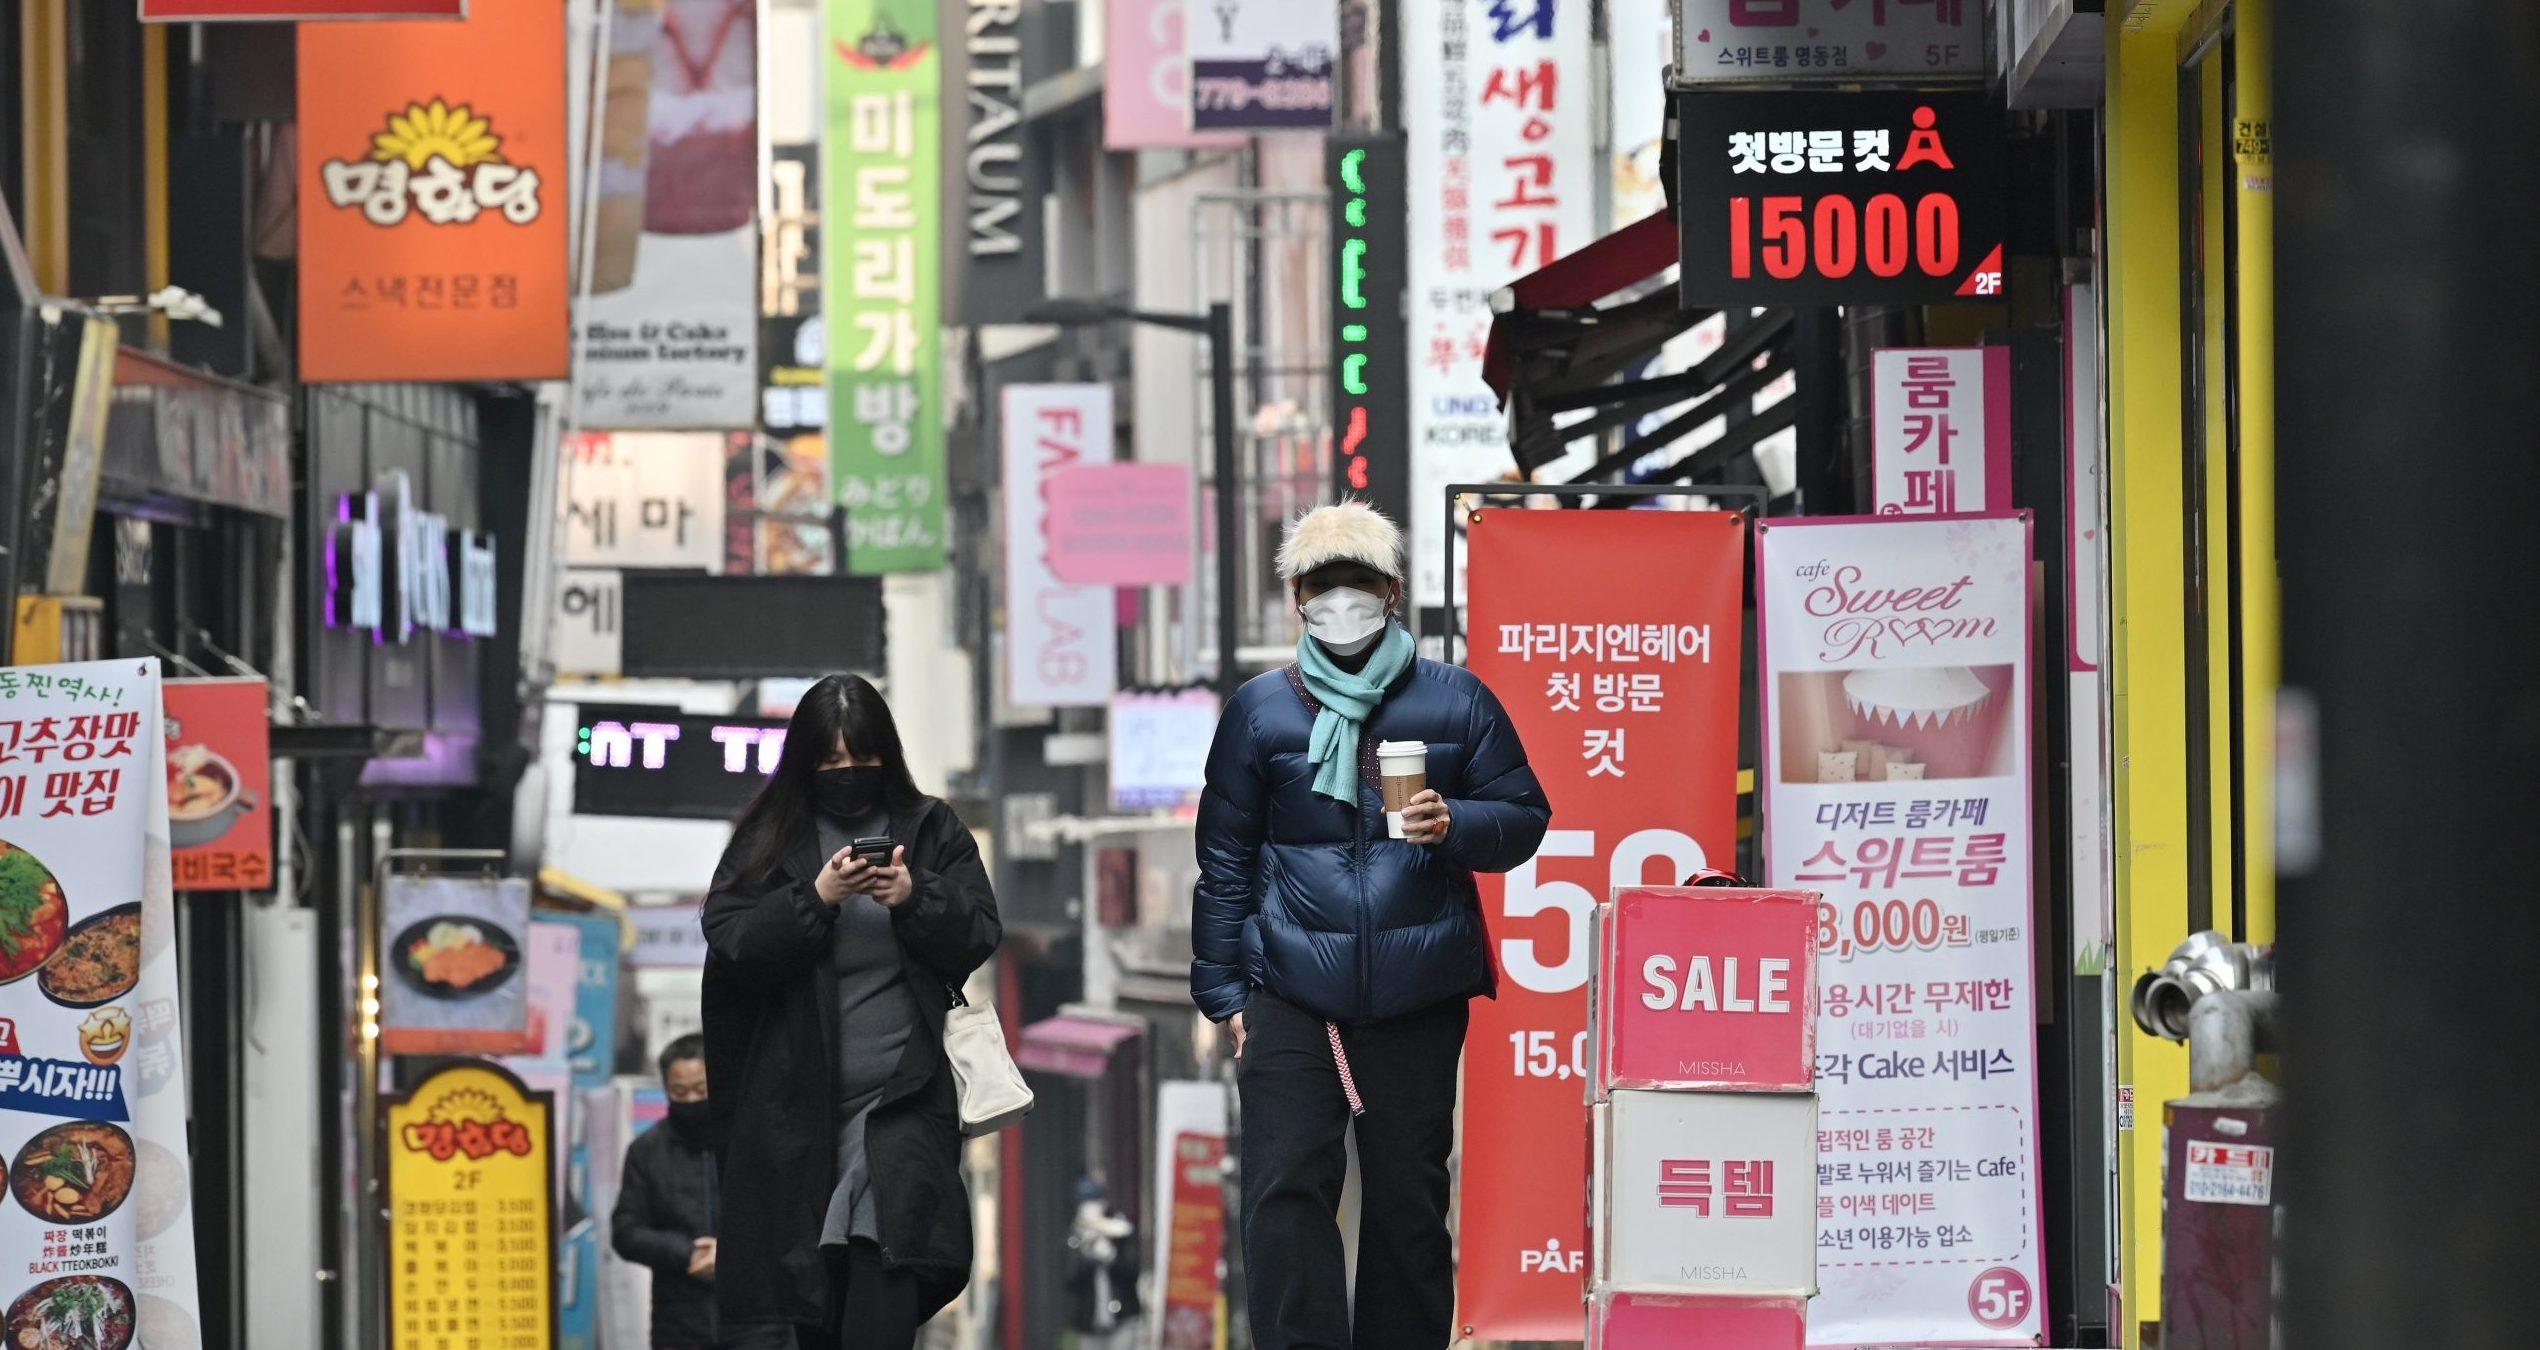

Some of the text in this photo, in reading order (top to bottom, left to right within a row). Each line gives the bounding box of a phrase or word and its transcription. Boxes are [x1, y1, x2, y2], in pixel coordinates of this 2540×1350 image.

[1717, 44, 1961, 67] 스위트룸 명동점 5F
[1481, 57, 1560, 268] 생고기
[1728, 129, 1891, 174] 첫방문 컷
[1730, 192, 1960, 280] 15000
[851, 90, 921, 453] 미도리가방
[1975, 272, 2002, 295] 2F
[341, 275, 518, 309] 스낵전문점
[1901, 356, 1959, 513] 룸카페
[1796, 559, 1830, 582] cafe
[1804, 565, 1974, 617] Sweet
[1498, 622, 1711, 664] 파리지엔헤어
[1545, 672, 1664, 713] 첫 방문
[0, 711, 141, 763] 고추장맛
[1582, 728, 1625, 778] 컷
[40, 768, 120, 819] 맛집
[1816, 798, 1989, 831] 디저트 룸카페
[173, 852, 265, 882] 비국수
[1795, 833, 2007, 889] 스위트룸
[1641, 954, 1790, 1013] SALE
[1818, 979, 2014, 1017] 용시간 무제한
[1851, 1018, 1960, 1040] (대기없을 시)
[1678, 1060, 1746, 1076] MISSHA
[1858, 1050, 1925, 1080] Cake
[1932, 1048, 2015, 1081] 서비스
[1817, 1127, 1936, 1152] 립적인 룸 공간
[453, 1170, 482, 1190] 2F
[1656, 1158, 1775, 1220] 득템
[1817, 1157, 2016, 1186] 발로 누워서 즐기는 Cafe
[1817, 1192, 1936, 1218] 플 이색 데이트
[1817, 1224, 1973, 1250] 소년 이용가능 업소
[29, 1255, 118, 1274] BLACK TTEOKBOKKI
[1680, 1265, 1748, 1281] MISSHA
[1977, 1278, 2025, 1321] 5F
